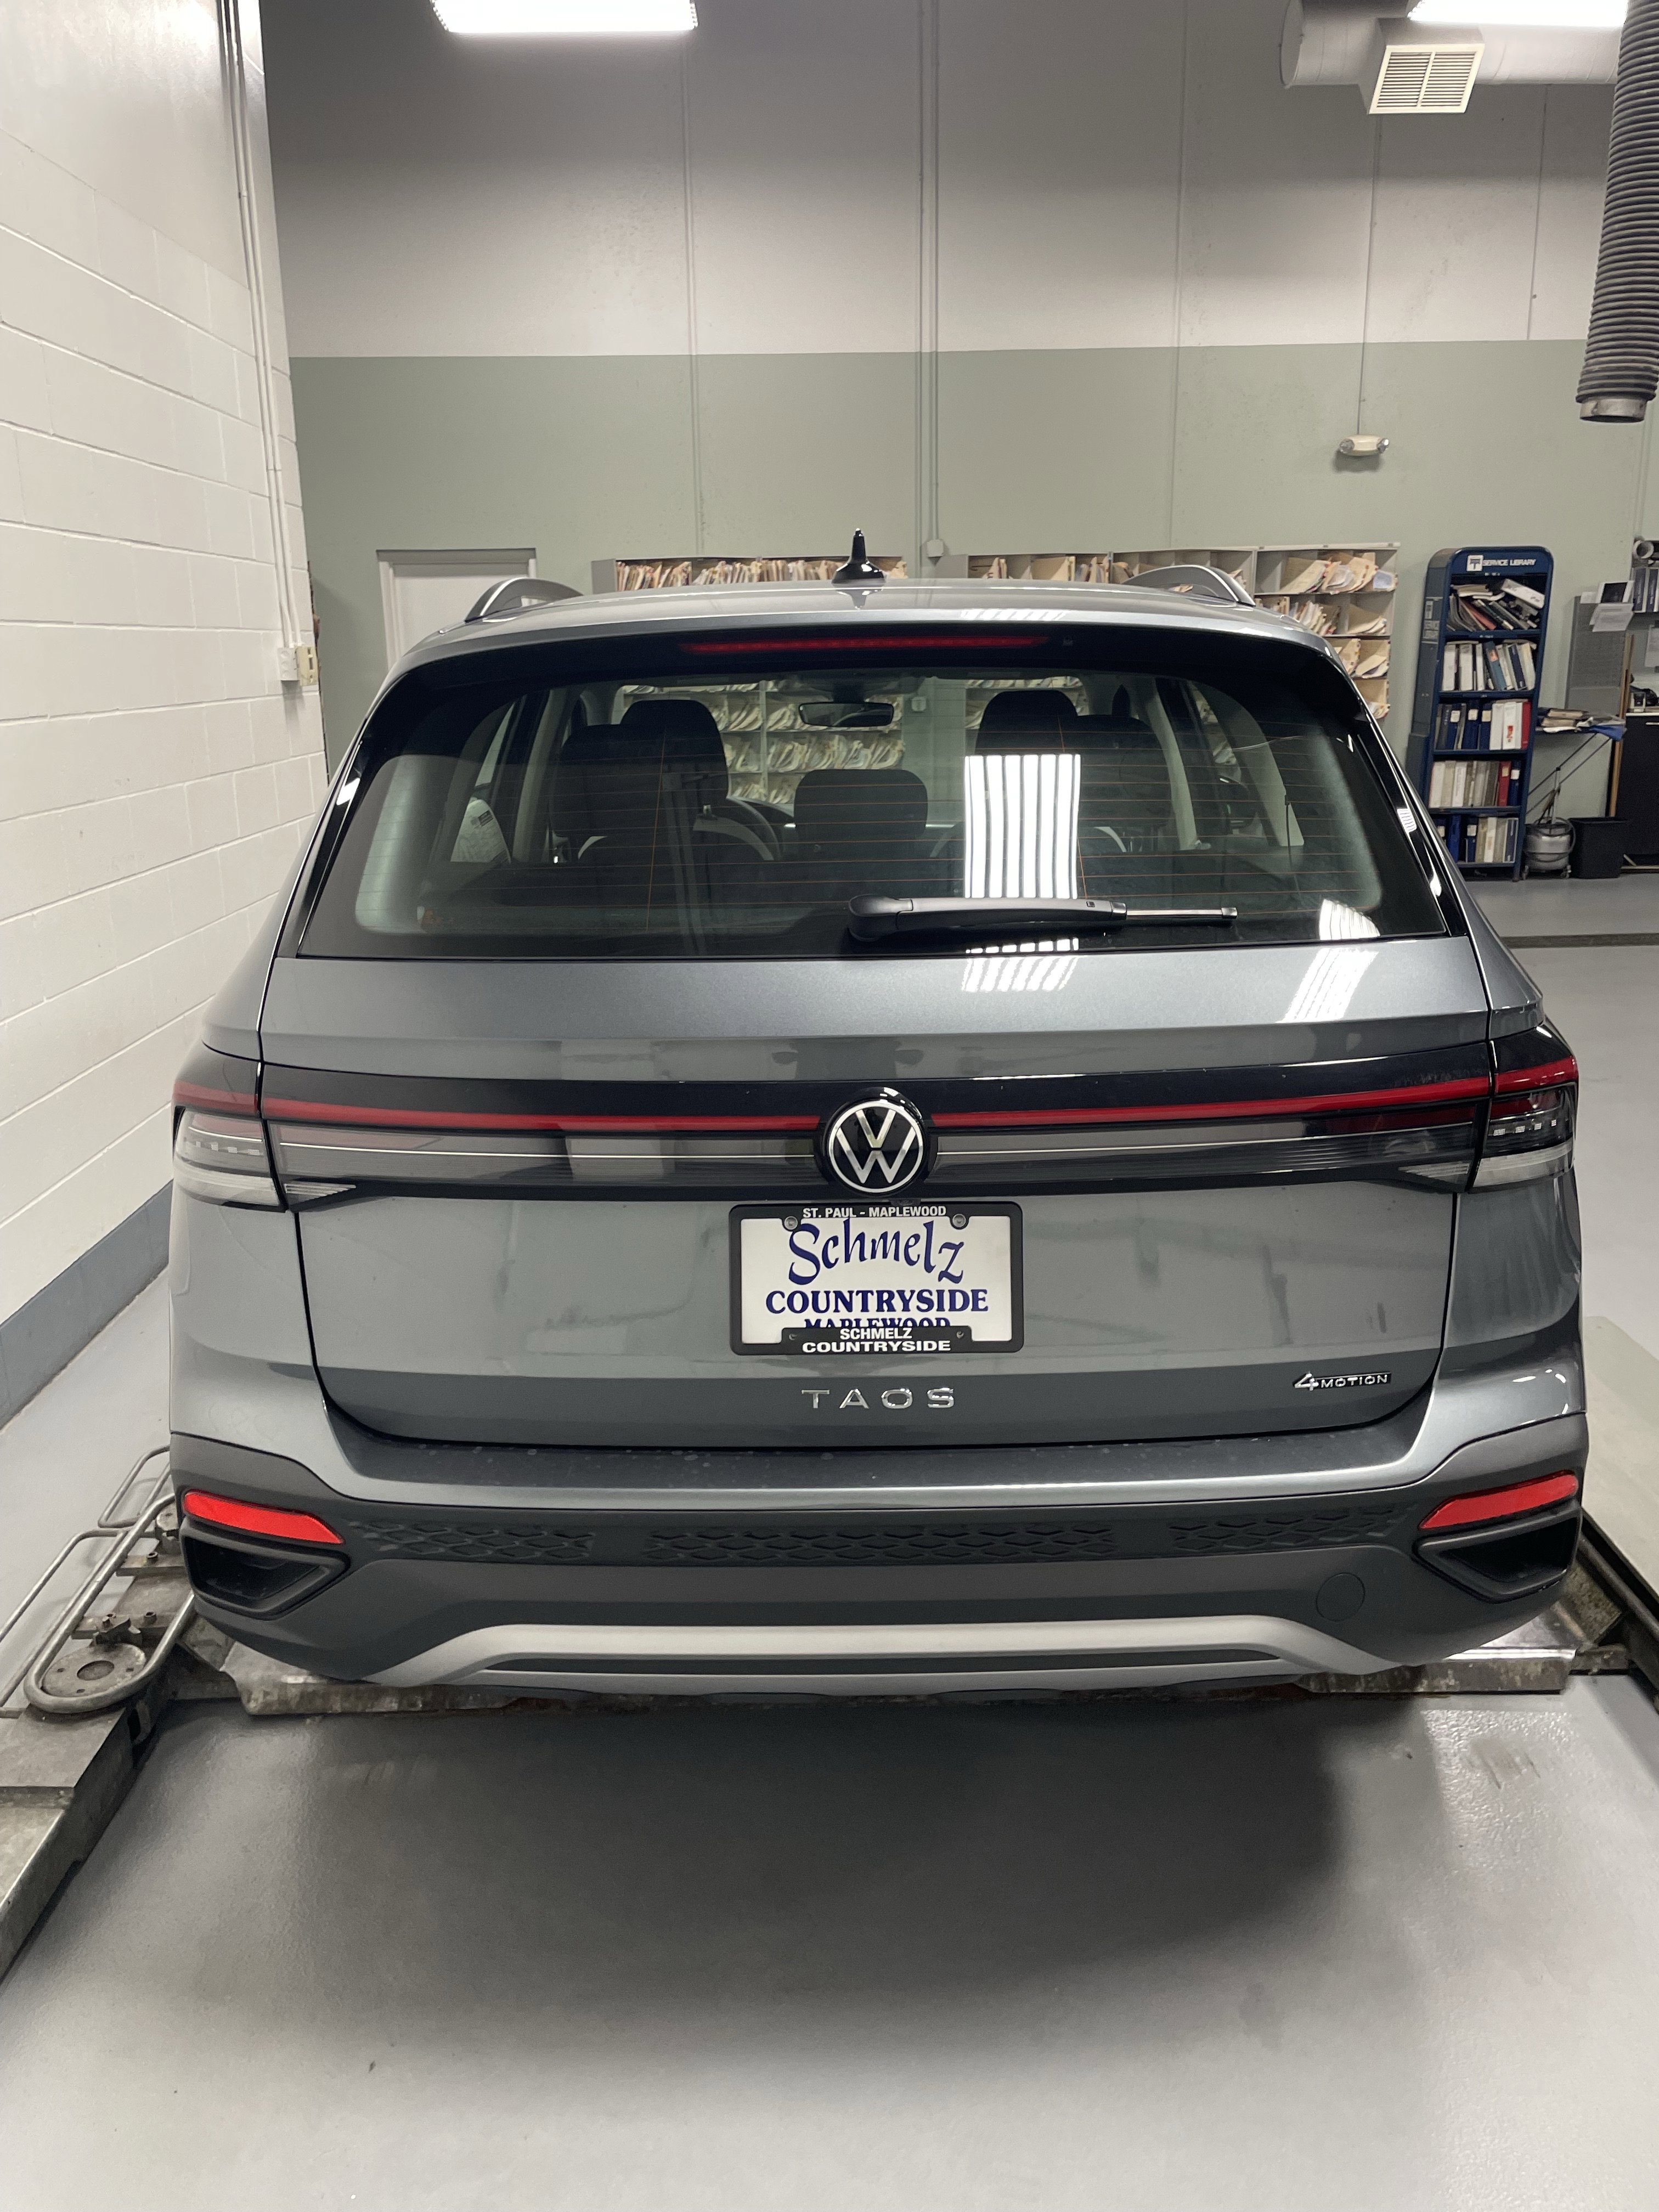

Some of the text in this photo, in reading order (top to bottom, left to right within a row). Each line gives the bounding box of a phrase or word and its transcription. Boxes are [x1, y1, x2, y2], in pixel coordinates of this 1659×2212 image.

[803, 1207, 822, 1218] ST.
[825, 1207, 857, 1217] PAUL
[868, 1206, 946, 1217] MAPLEWOOD
[788, 1218, 964, 1285] Schmelz
[766, 1289, 989, 1314] COUNTRYSIDE
[840, 1328, 912, 1340] SCHMELZ
[802, 1340, 951, 1353] COUNTRYSIDE
[802, 1387, 955, 1409] TAOS
